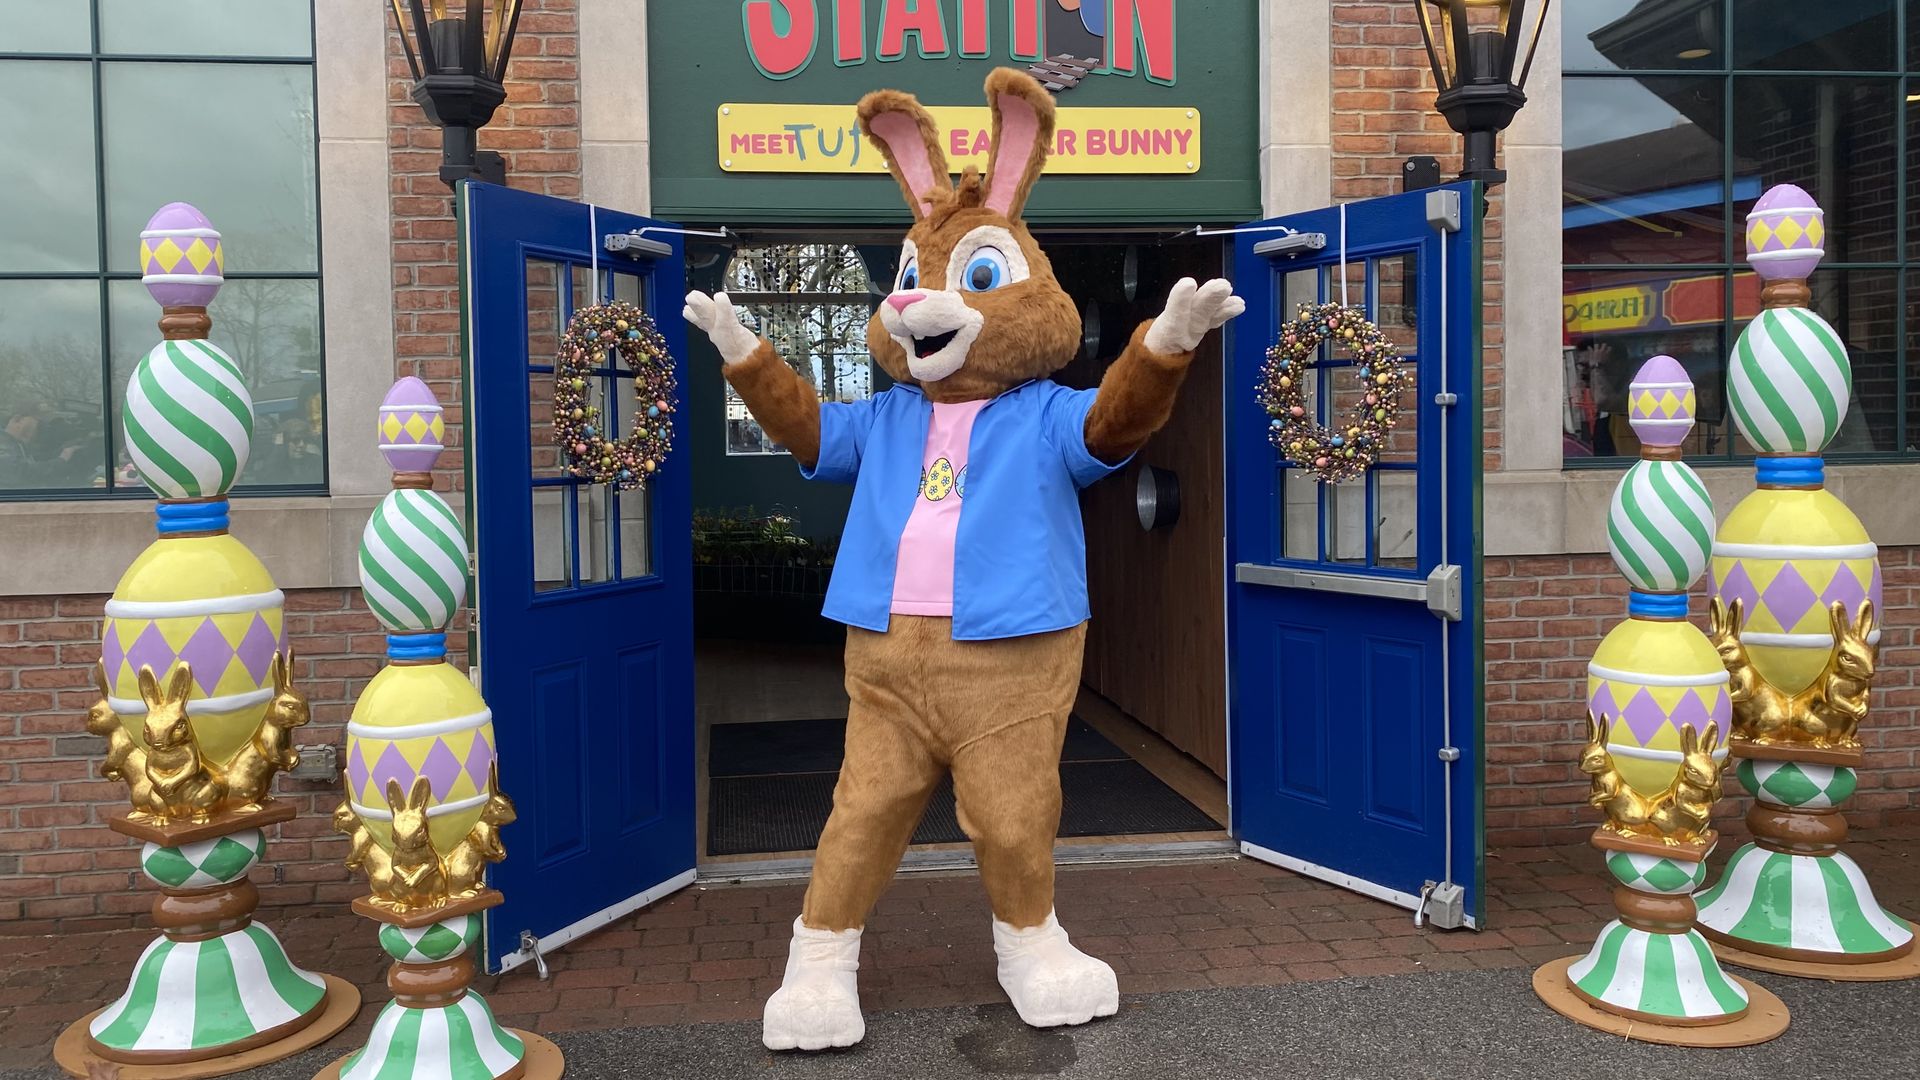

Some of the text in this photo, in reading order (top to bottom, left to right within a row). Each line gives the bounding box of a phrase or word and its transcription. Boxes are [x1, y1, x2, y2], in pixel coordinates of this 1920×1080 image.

[730, 133, 797, 154] MEET
[950, 129, 1077, 156] EAR
[1086, 128, 1193, 156] BUNNY
